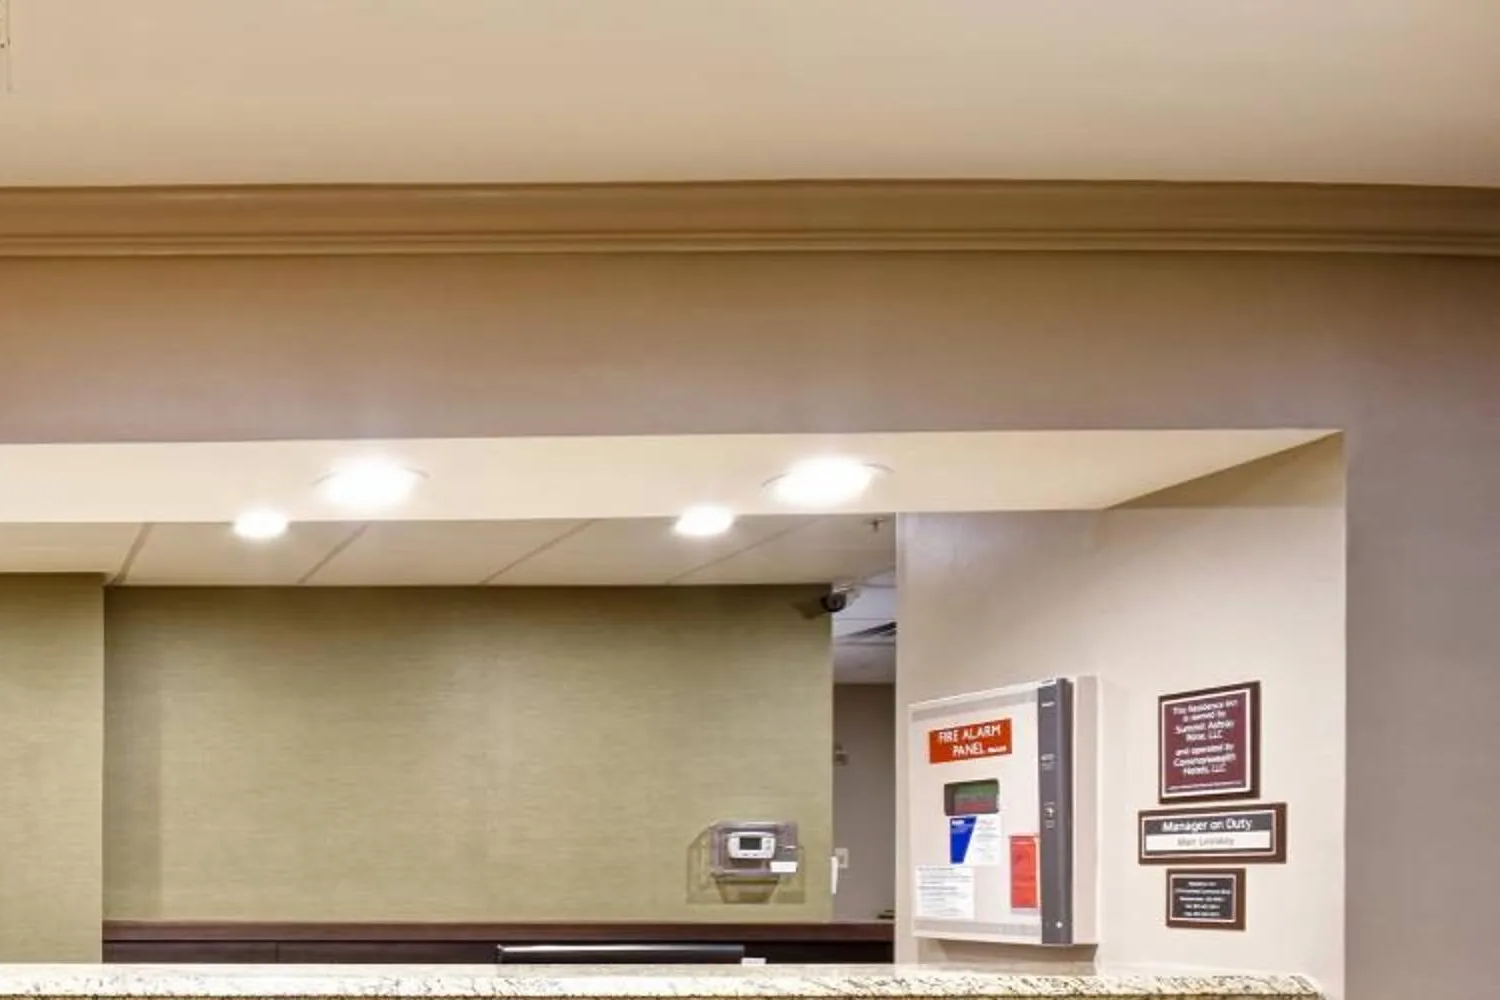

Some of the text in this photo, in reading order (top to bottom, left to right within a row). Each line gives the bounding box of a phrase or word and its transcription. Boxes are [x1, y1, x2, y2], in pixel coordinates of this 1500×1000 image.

[937, 724, 1001, 744] FIRE ALARM
[952, 741, 985, 758] PANEL
[1162, 817, 1252, 832] Manager on Duty
